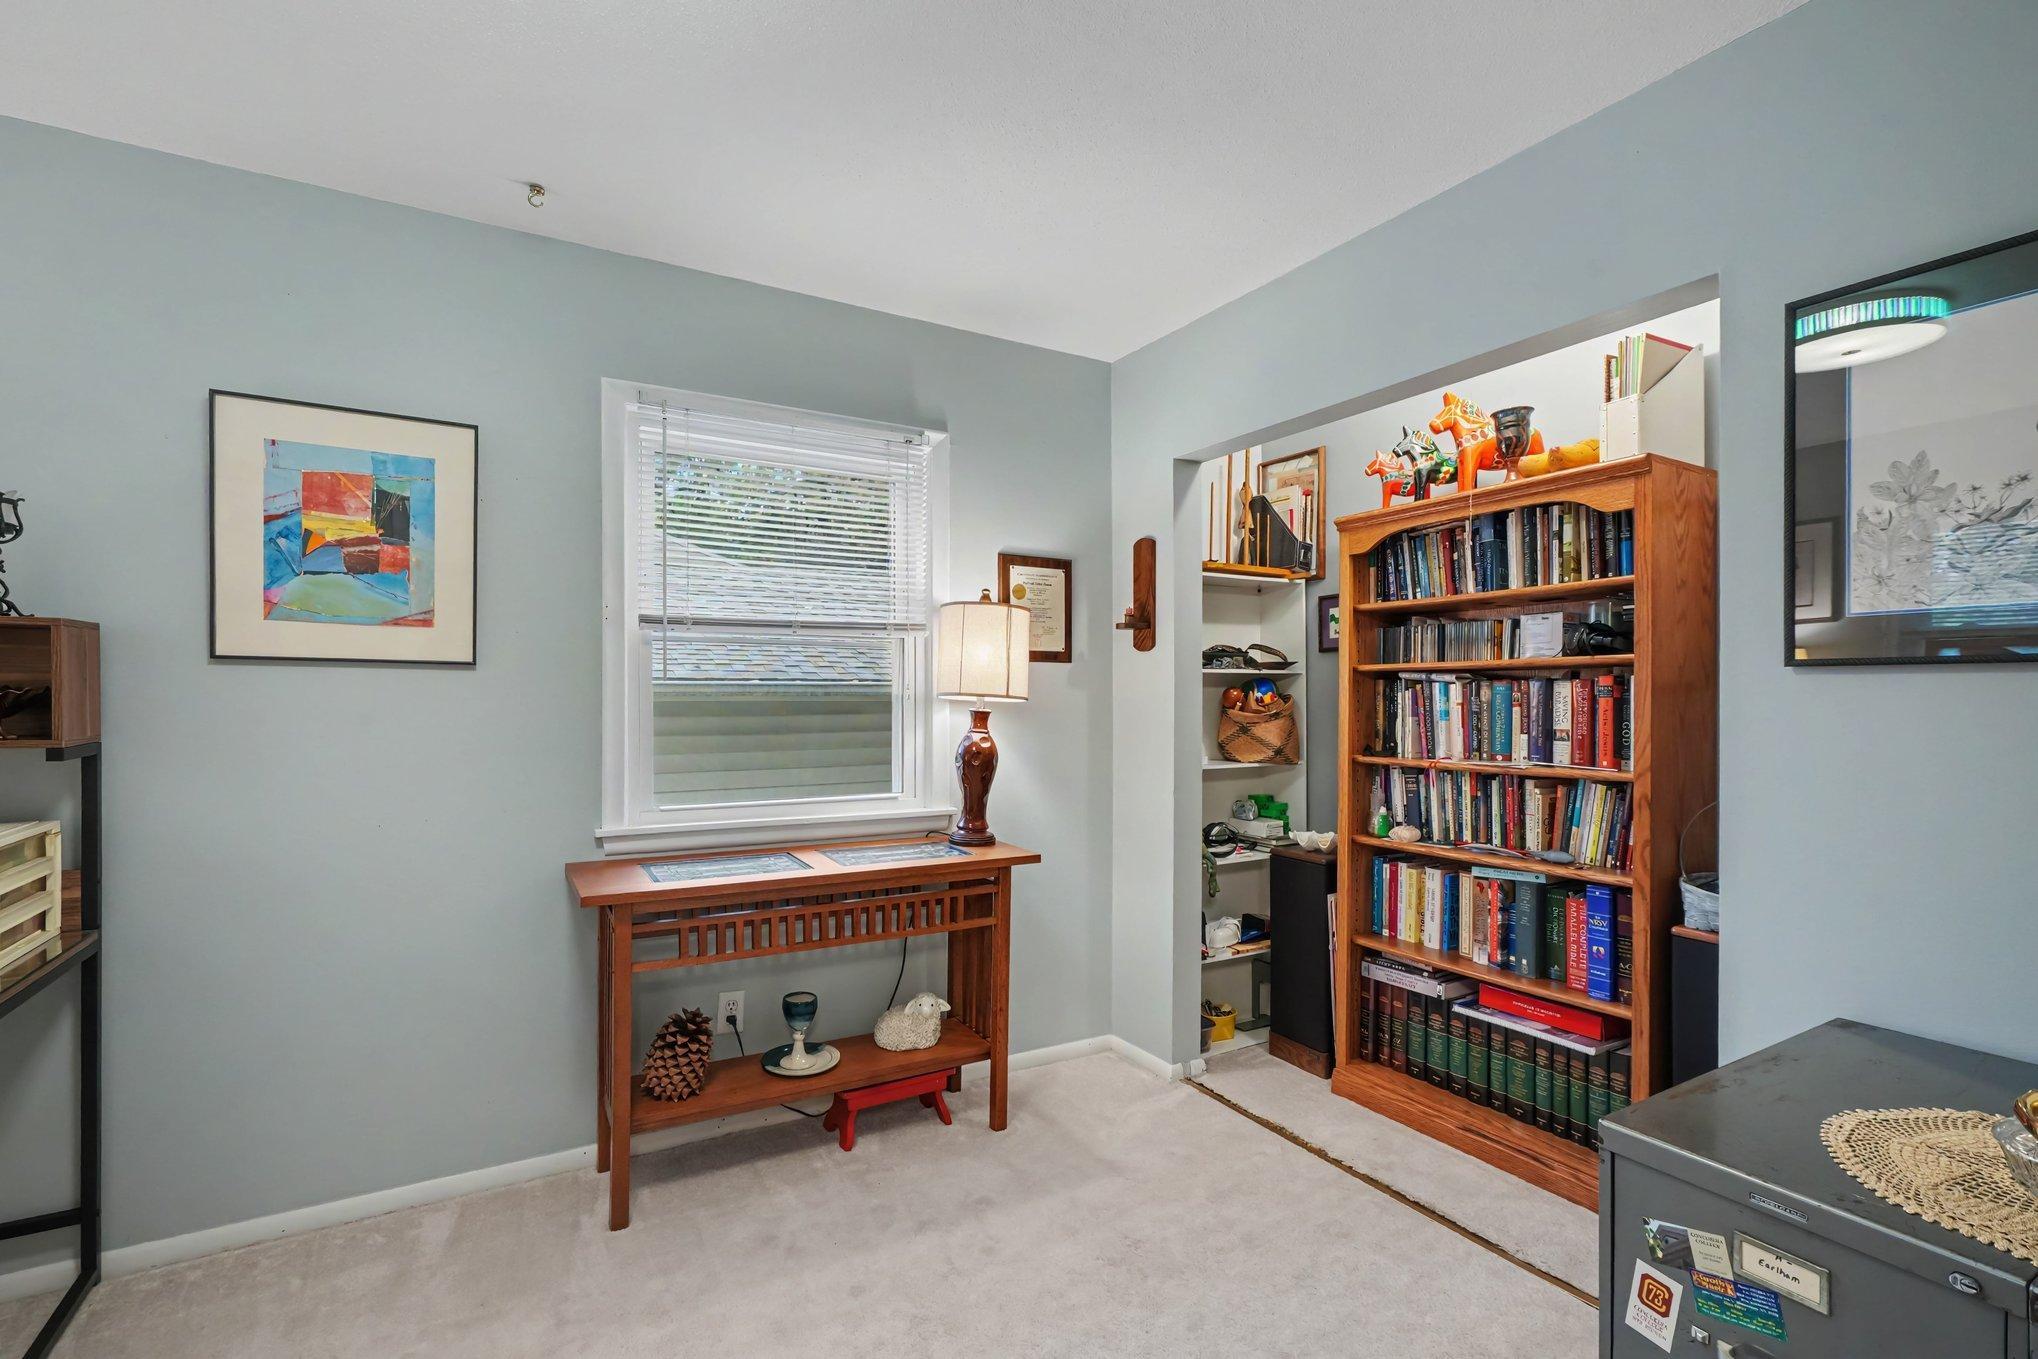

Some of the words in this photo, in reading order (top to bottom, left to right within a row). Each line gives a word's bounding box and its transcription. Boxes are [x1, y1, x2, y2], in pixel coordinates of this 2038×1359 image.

[1622, 721, 1631, 746] GOD
[1589, 918, 1608, 927] NRSV
[1758, 1259, 1800, 1284] Earlham
[1649, 1285, 1664, 1307] 73
